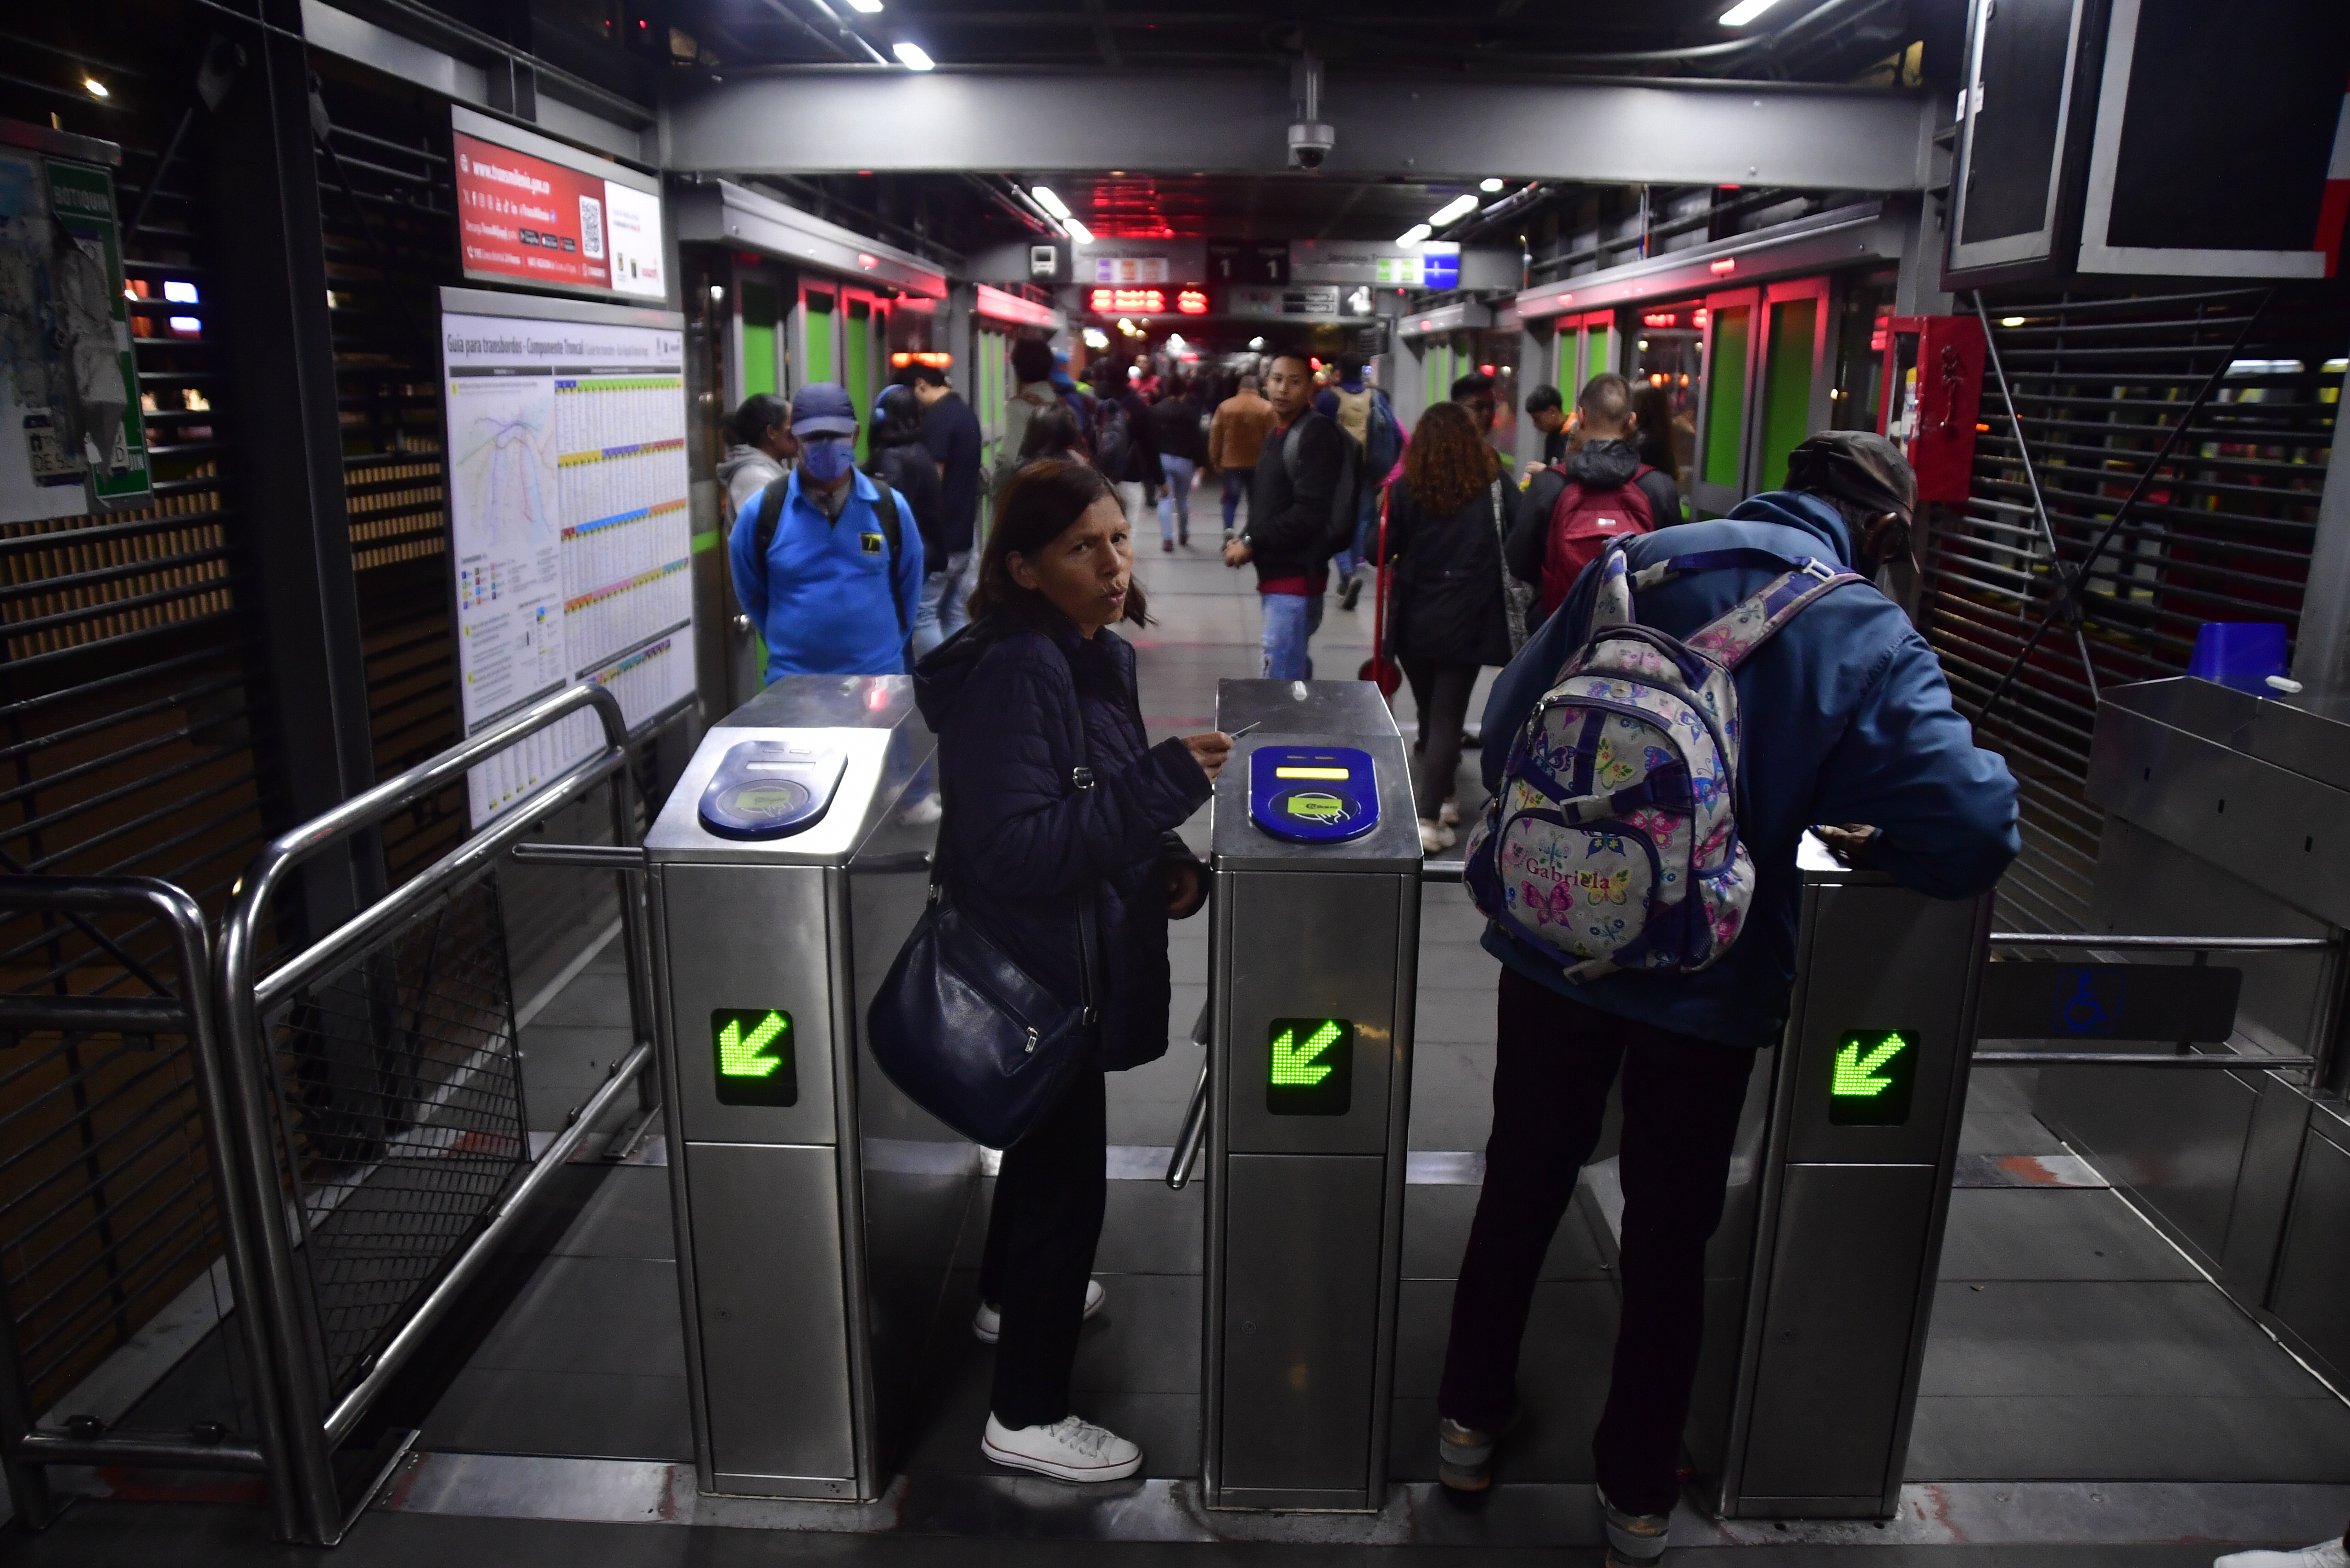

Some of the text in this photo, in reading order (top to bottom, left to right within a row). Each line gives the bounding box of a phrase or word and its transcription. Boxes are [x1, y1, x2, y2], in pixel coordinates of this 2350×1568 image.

[53, 185, 109, 212] BOTIQUIN
[1220, 259, 1230, 277] 1
[1267, 260, 1277, 279] 1
[448, 333, 464, 353] Guía
[465, 339, 482, 358] para
[1526, 857, 1610, 889] Gabriela
